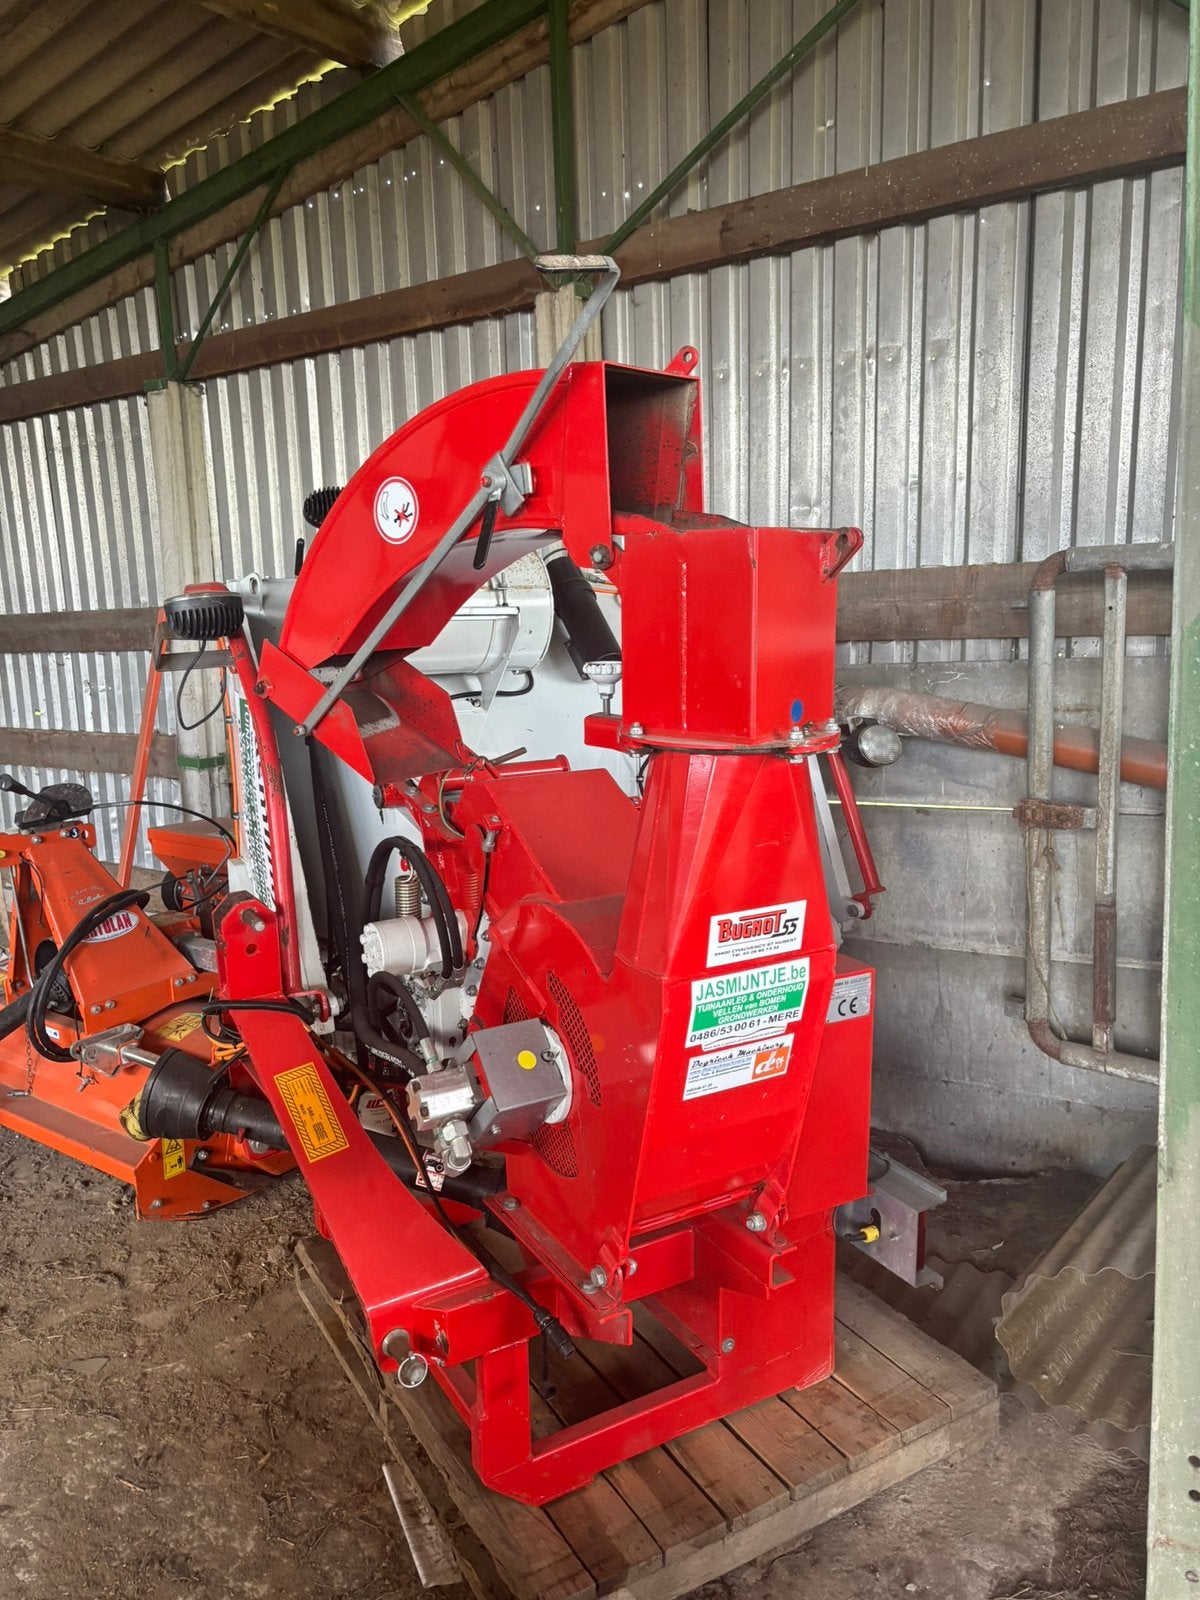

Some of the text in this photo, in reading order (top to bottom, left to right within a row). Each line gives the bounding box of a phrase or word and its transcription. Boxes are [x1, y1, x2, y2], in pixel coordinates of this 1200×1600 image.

[717, 909, 787, 943] BUGNOT
[696, 964, 806, 1002] JASMIJNTJE.be
[698, 995, 747, 1013] TUINAANLEG
[756, 983, 804, 1000] ONDERHOUD
[712, 994, 787, 1018] VELLEN van BOMEN
[837, 996, 858, 1016] CE
[717, 1004, 779, 1024] GRONDWERKEN
[767, 1009, 801, 1024] MERE
